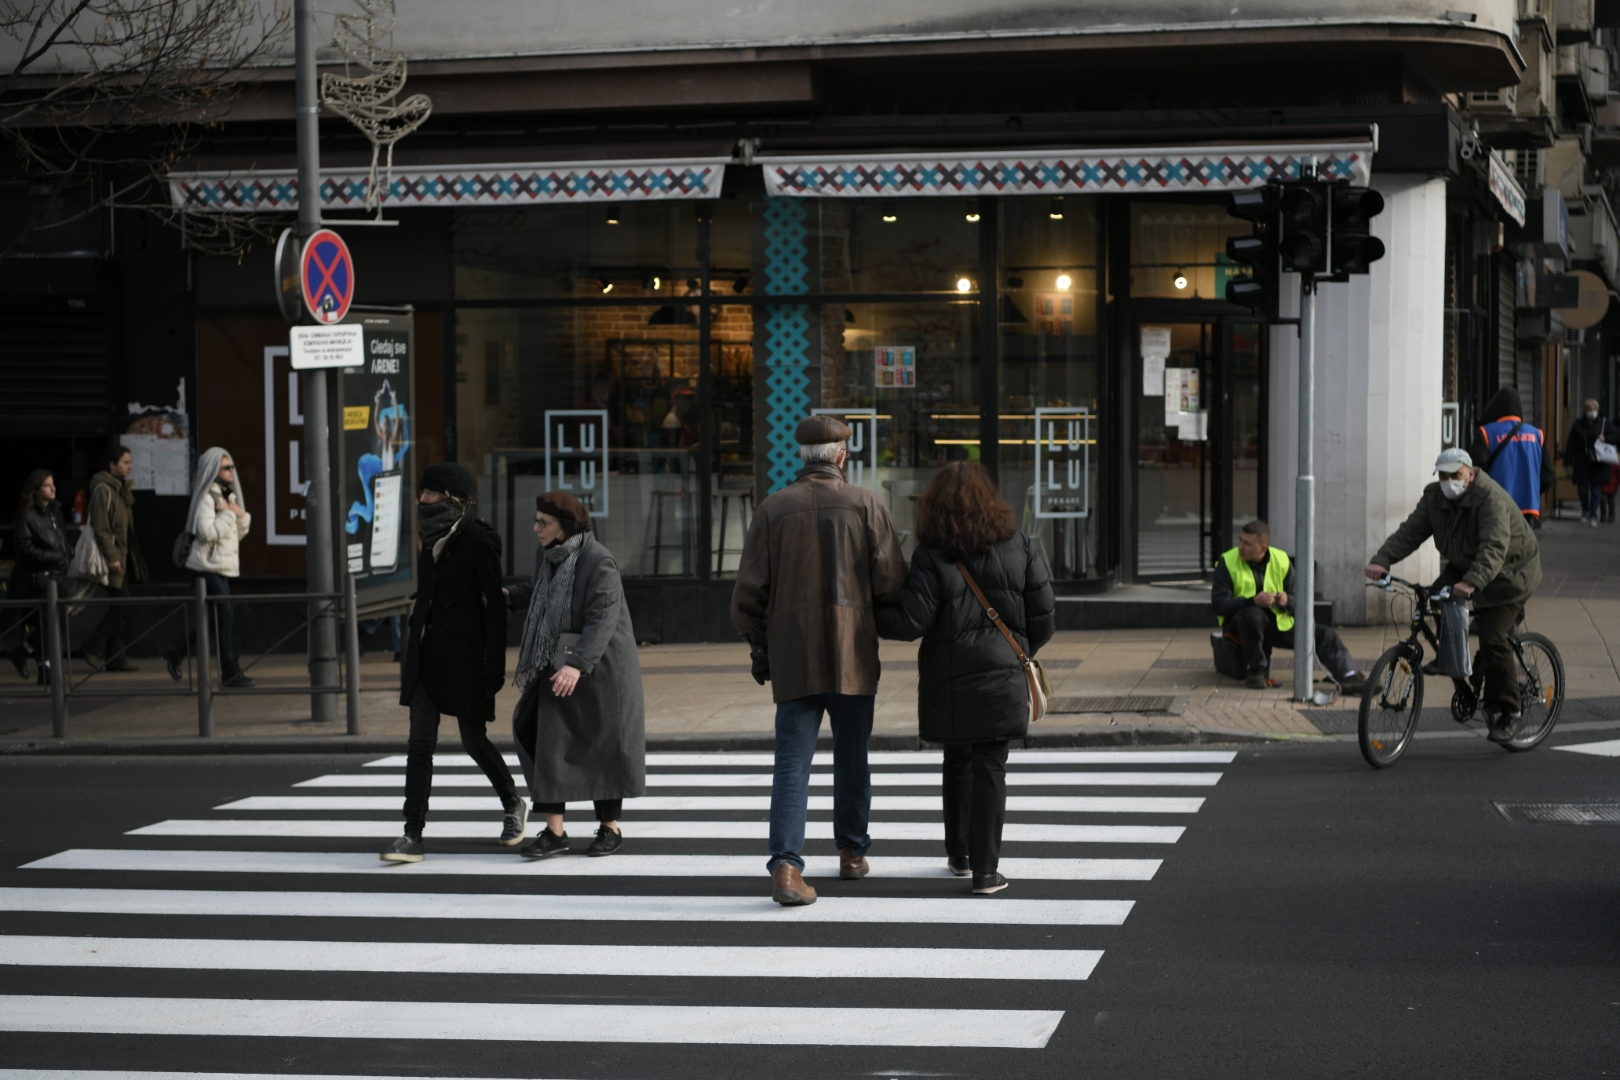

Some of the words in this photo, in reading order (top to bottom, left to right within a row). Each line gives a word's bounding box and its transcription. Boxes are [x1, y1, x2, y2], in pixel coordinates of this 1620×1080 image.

[370, 338, 394, 358] Gledaj
[394, 342, 407, 355] sve
[557, 422, 595, 453] LU
[1047, 420, 1080, 452] LU
[557, 459, 596, 490] LU
[1047, 458, 1080, 490] LU
